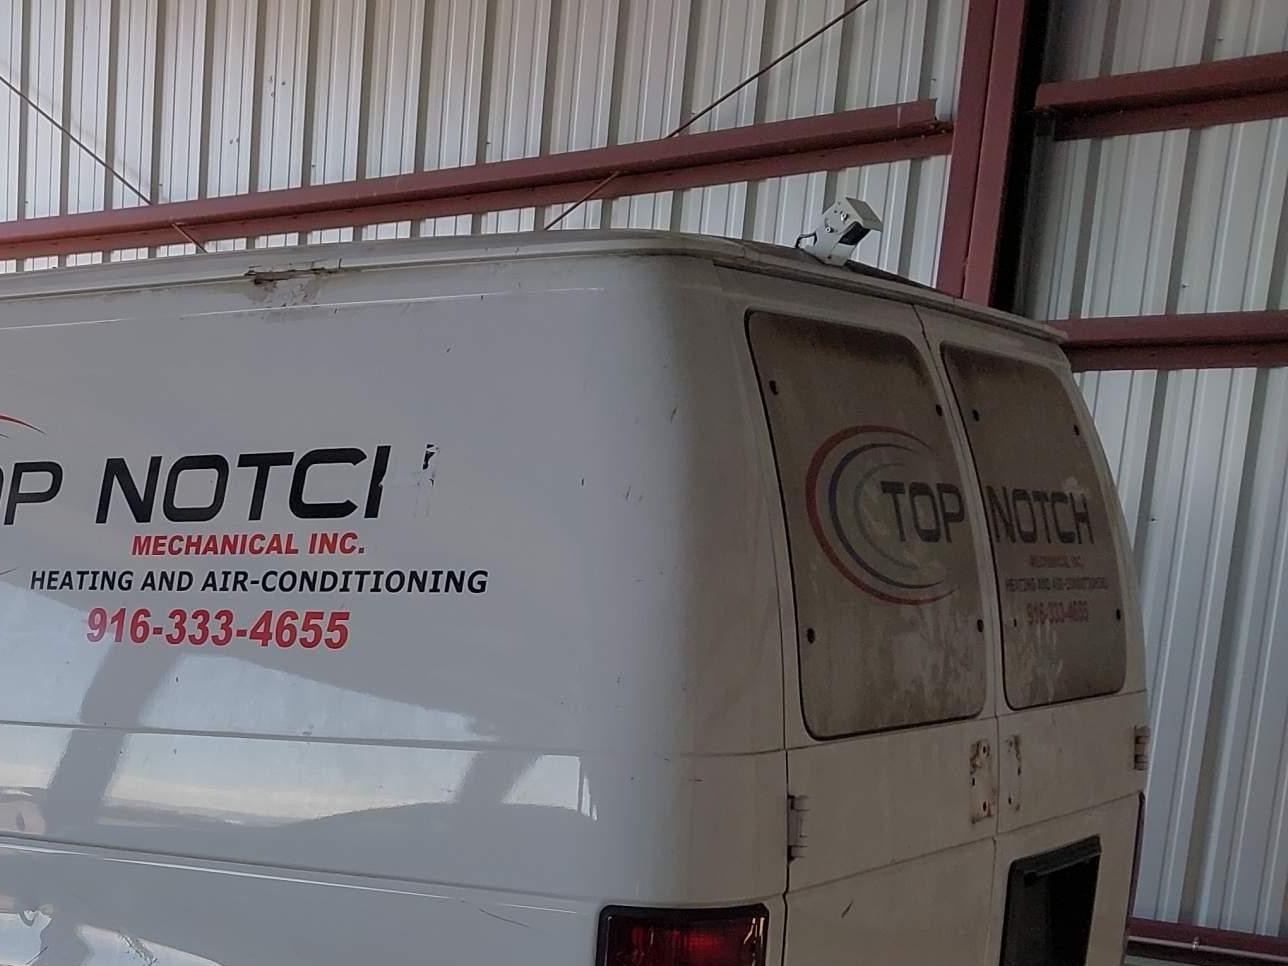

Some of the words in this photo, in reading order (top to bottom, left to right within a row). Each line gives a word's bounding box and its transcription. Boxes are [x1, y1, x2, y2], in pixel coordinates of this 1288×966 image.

[880, 481, 965, 543] TOP
[986, 485, 1095, 544] NOTCH
[132, 533, 299, 556] MECHANICAL
[309, 532, 365, 555] INC.
[30, 570, 133, 591] HEATING
[141, 571, 193, 592] AND
[201, 570, 489, 593] AIR-CONDITIONING
[87, 607, 350, 650] 916-333-4655
